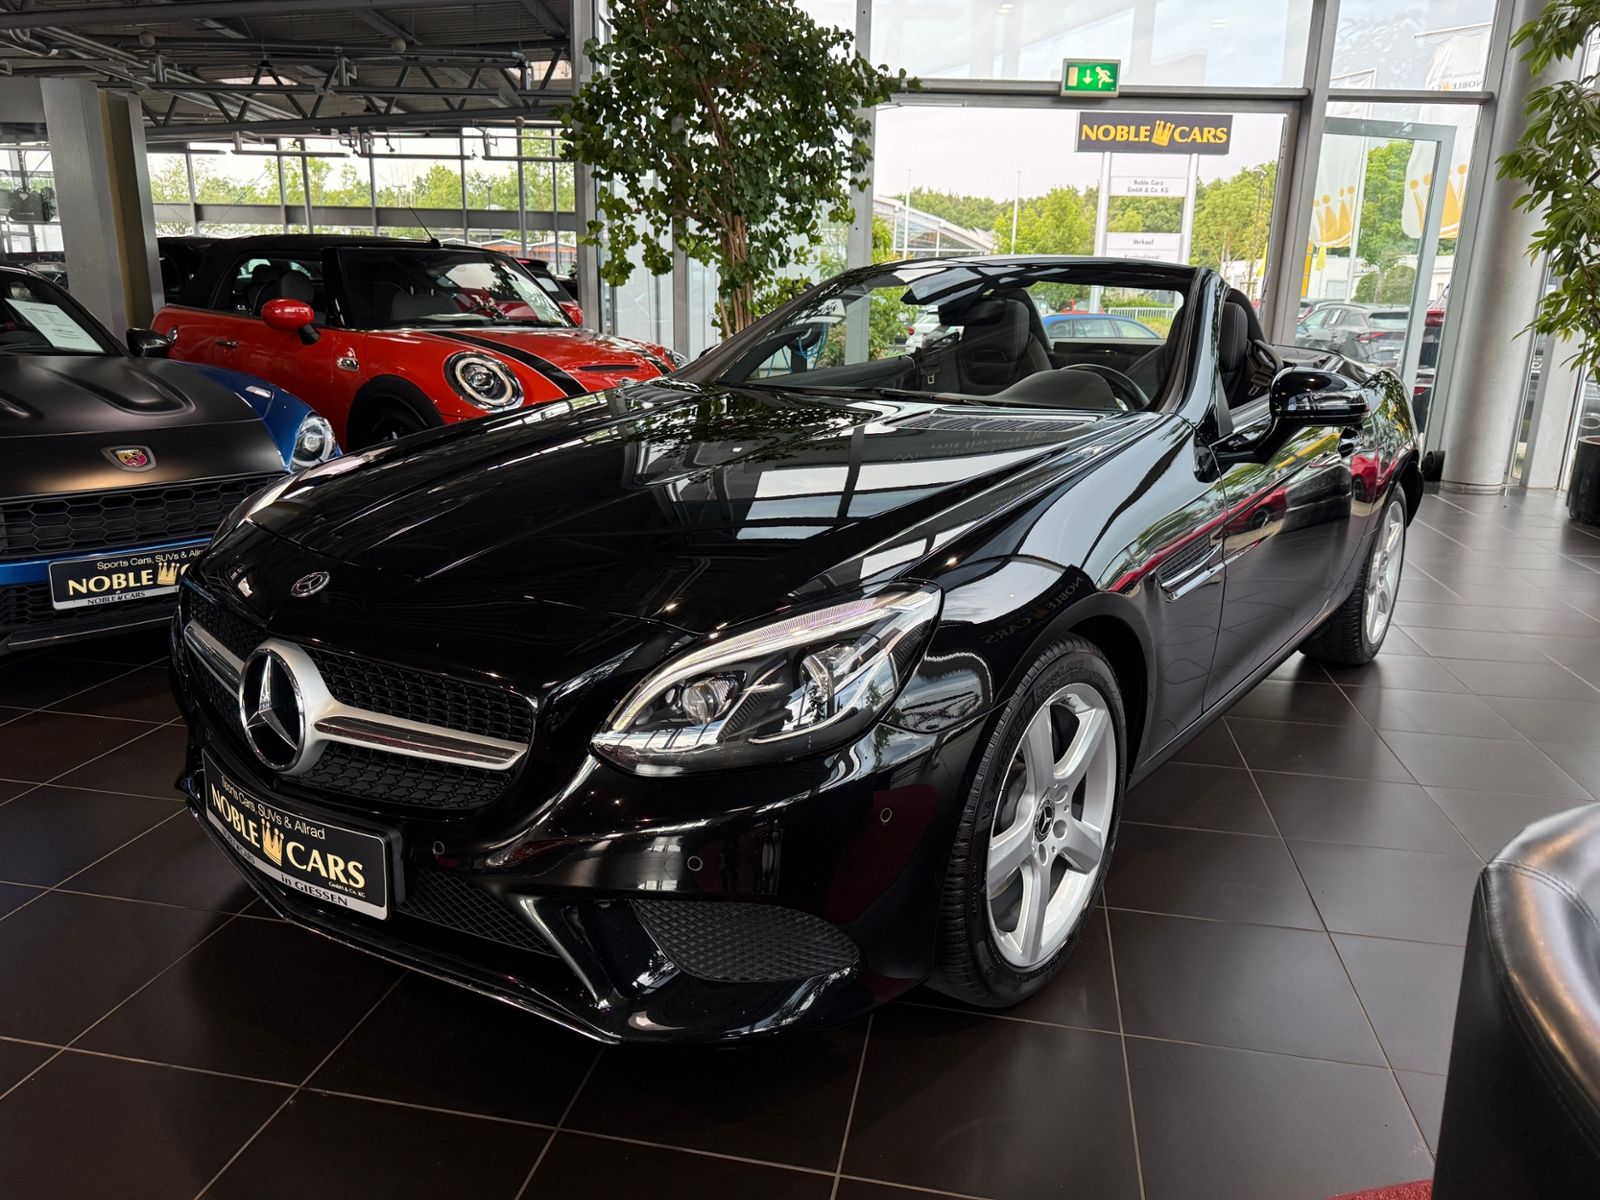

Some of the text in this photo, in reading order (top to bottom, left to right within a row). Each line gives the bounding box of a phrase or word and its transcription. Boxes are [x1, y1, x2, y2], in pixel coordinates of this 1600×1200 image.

[1081, 124, 1228, 144] NOBLE CARS
[96, 559, 129, 571] Sports
[129, 557, 154, 566] Cars,
[154, 552, 179, 563] SUVs
[180, 551, 187, 559] &
[67, 569, 154, 596] NOBLE
[87, 590, 146, 605] NOBLE CARS
[210, 782, 366, 889] NOBLE CARS
[257, 803, 283, 826] SUVs
[283, 815, 293, 830] &
[294, 820, 326, 841] Allrad
[281, 873, 292, 886] in
[294, 881, 348, 907] GIESSEN
